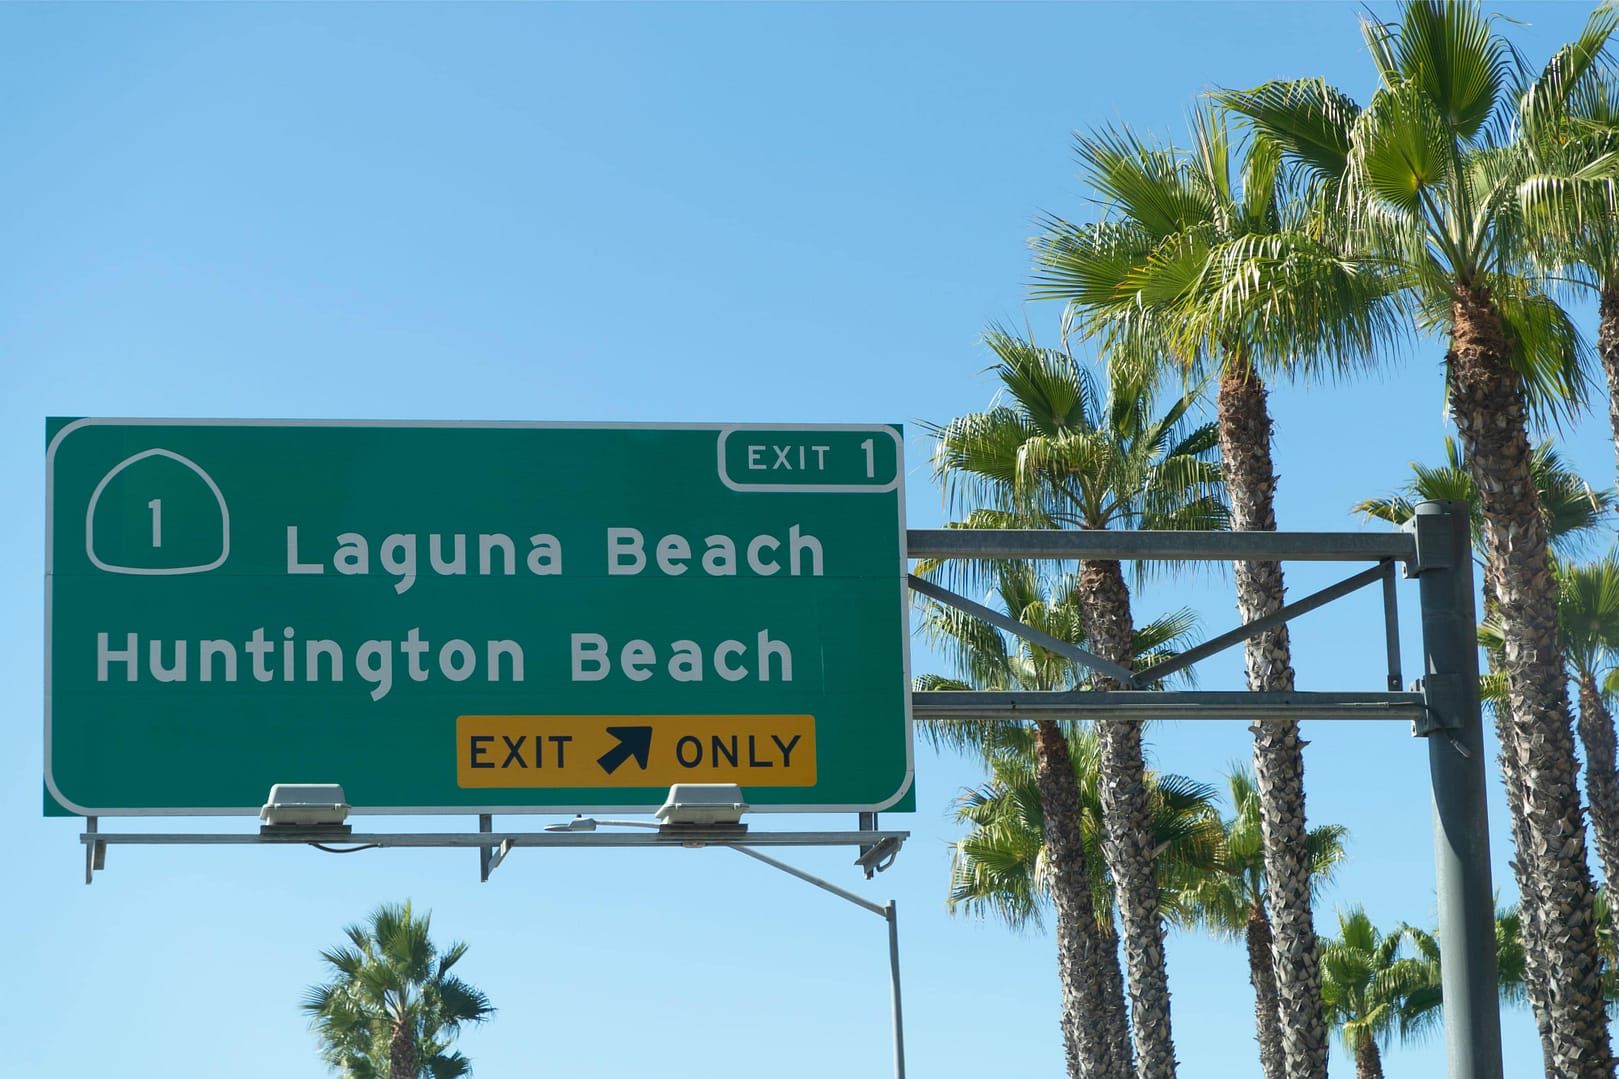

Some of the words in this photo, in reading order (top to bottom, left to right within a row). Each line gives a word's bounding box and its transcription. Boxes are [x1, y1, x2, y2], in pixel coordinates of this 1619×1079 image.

[747, 445, 831, 470] EXIT
[860, 438, 876, 478] 1
[147, 499, 162, 547] 1
[286, 526, 562, 595] Laguna
[607, 524, 824, 576] Beach
[97, 626, 525, 702] Huntington
[571, 628, 793, 682] Beach
[470, 735, 574, 769] EXIT
[676, 734, 802, 769] ONLY
